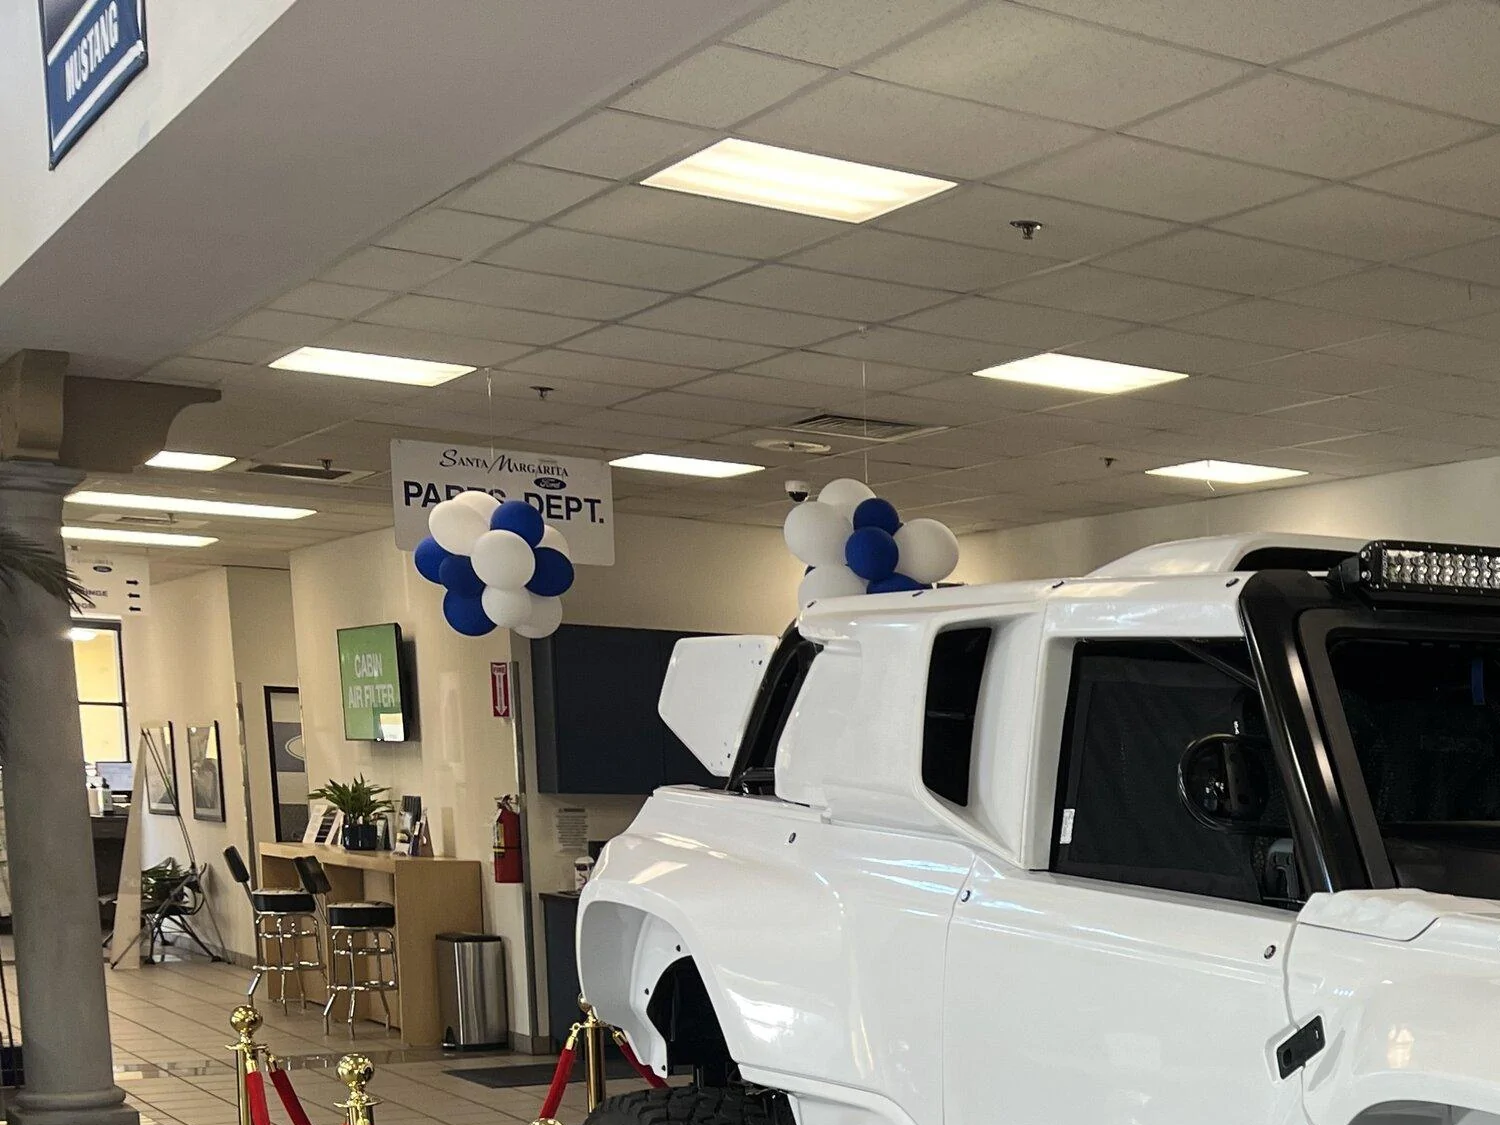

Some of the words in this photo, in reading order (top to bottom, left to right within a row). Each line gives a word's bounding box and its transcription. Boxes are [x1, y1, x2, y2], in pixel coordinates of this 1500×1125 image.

[64, 0, 119, 103] MUSTANG
[439, 449, 489, 469] SANTA
[487, 454, 569, 478] MARGARITA
[403, 481, 506, 509] PAR
[524, 492, 605, 524] DEPT.
[354, 652, 383, 678] CABIN
[348, 685, 363, 708] AIR
[364, 683, 396, 708] FILTER
